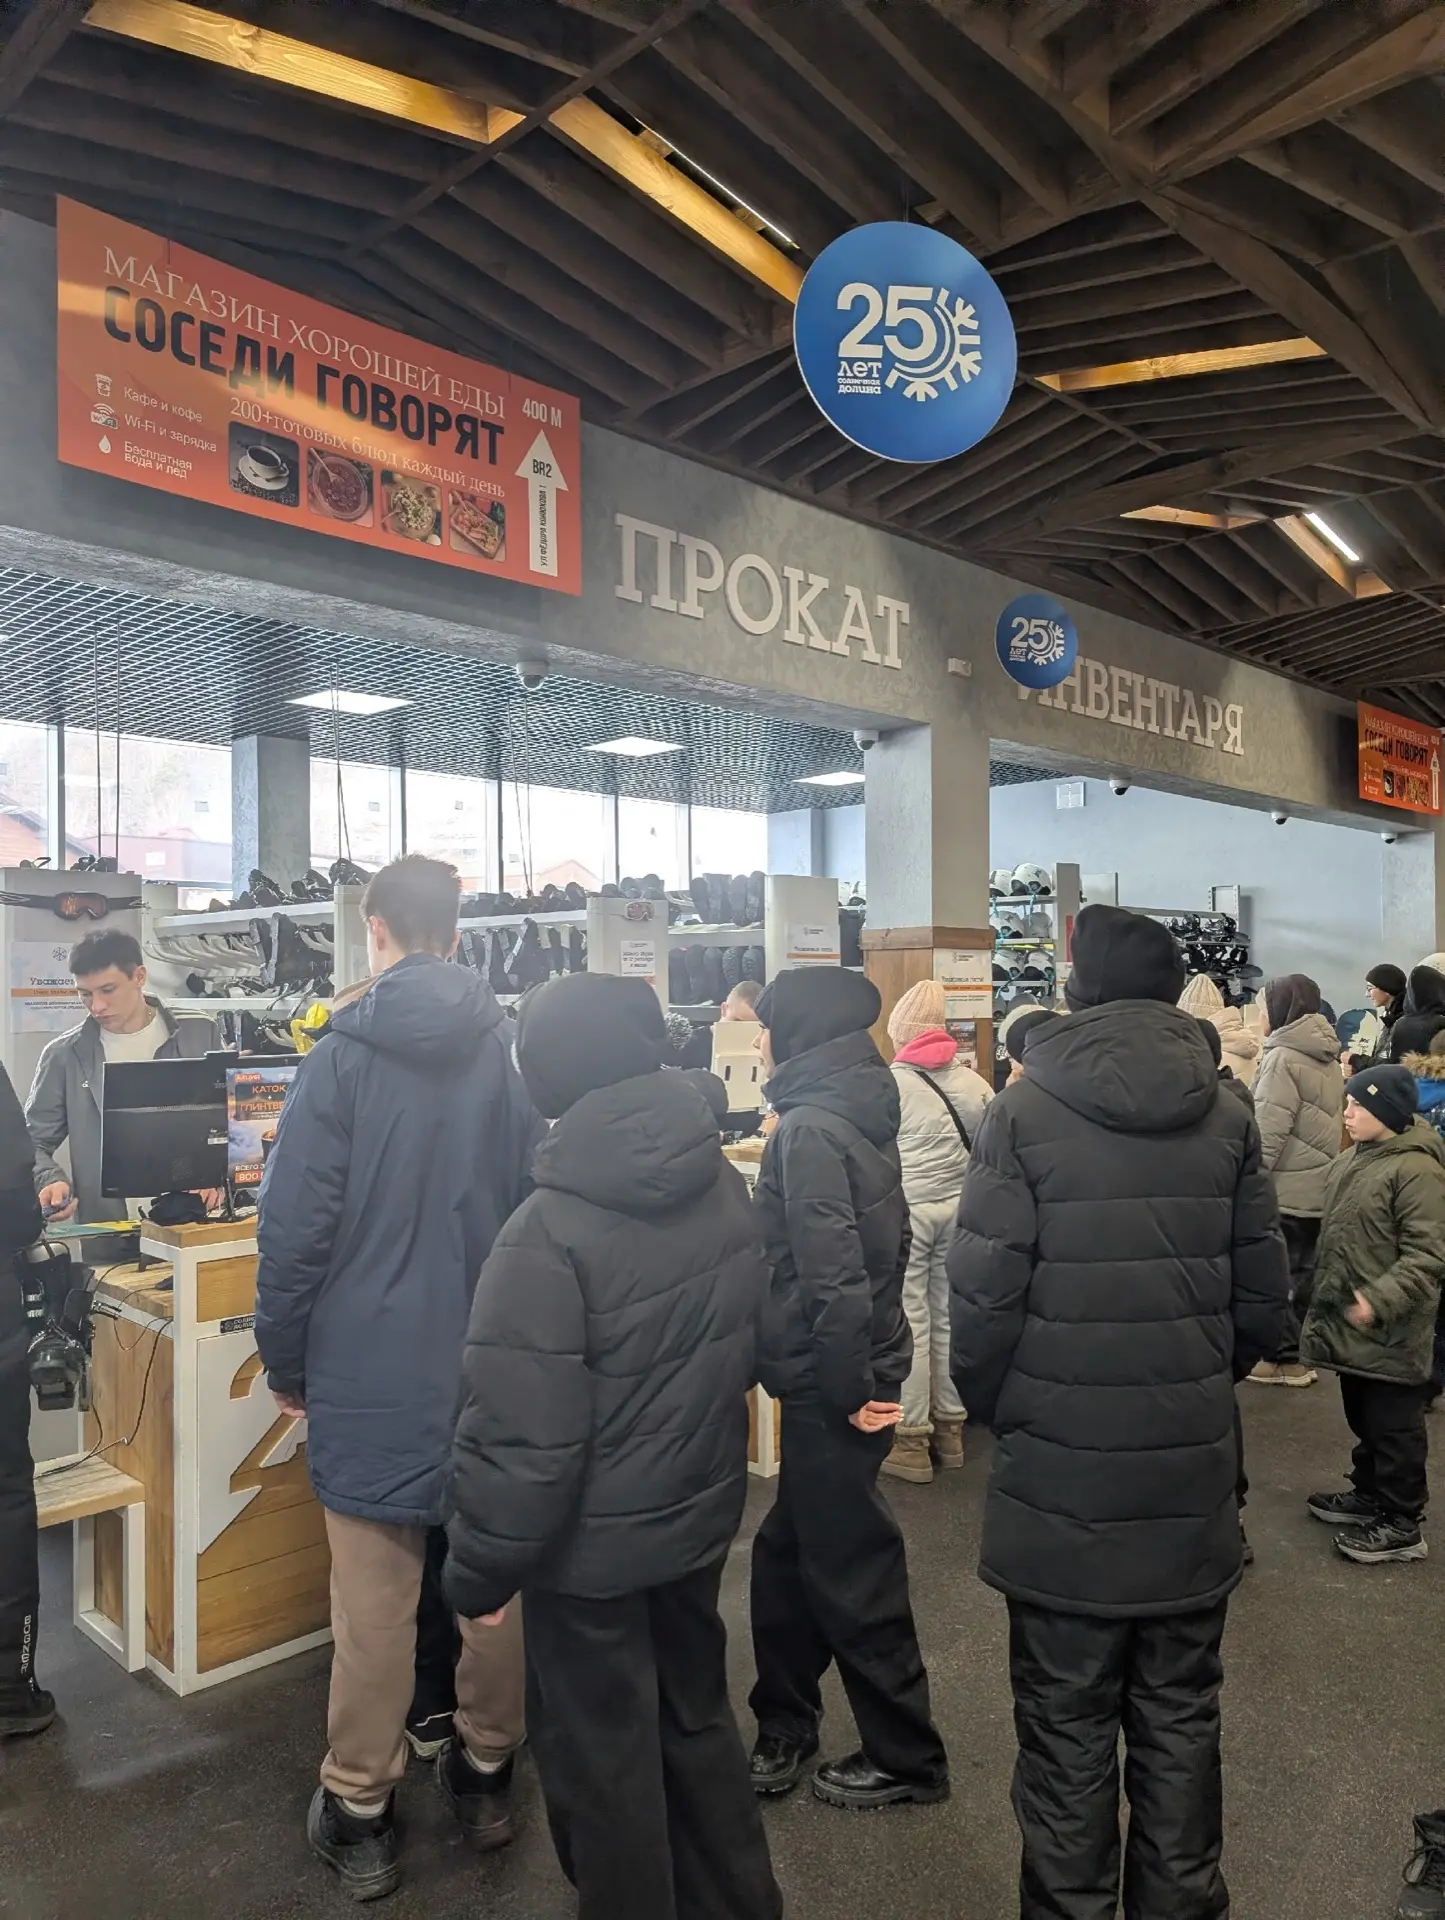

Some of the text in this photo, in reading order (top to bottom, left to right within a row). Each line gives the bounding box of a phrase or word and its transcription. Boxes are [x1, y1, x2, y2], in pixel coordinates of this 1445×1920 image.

[104, 246, 506, 419] МАГАЗИН ХОРОШЕЙ ЕДЫ
[836, 282, 938, 362] 25
[104, 285, 505, 466] СОСЕДИ ГОВОРЯТ
[124, 387, 203, 423] Кафе и кофе
[522, 398, 562, 429] 400 М
[124, 413, 217, 453] Wi-Fi и зарядка
[124, 441, 193, 471] Бесплатная
[124, 453, 188, 479] вода и лед
[352, 436, 398, 469] блюд
[402, 456, 467, 487] каждый
[468, 476, 506, 498] день
[532, 458, 553, 479] BR2
[614, 512, 910, 670] ПРОКАТ
[1010, 616, 1049, 650] 25
[1017, 656, 1245, 756] НВЕНТАРЯ
[252, 1085, 287, 1094] КАТОК
[21, 1614, 32, 1675] BOGNER
